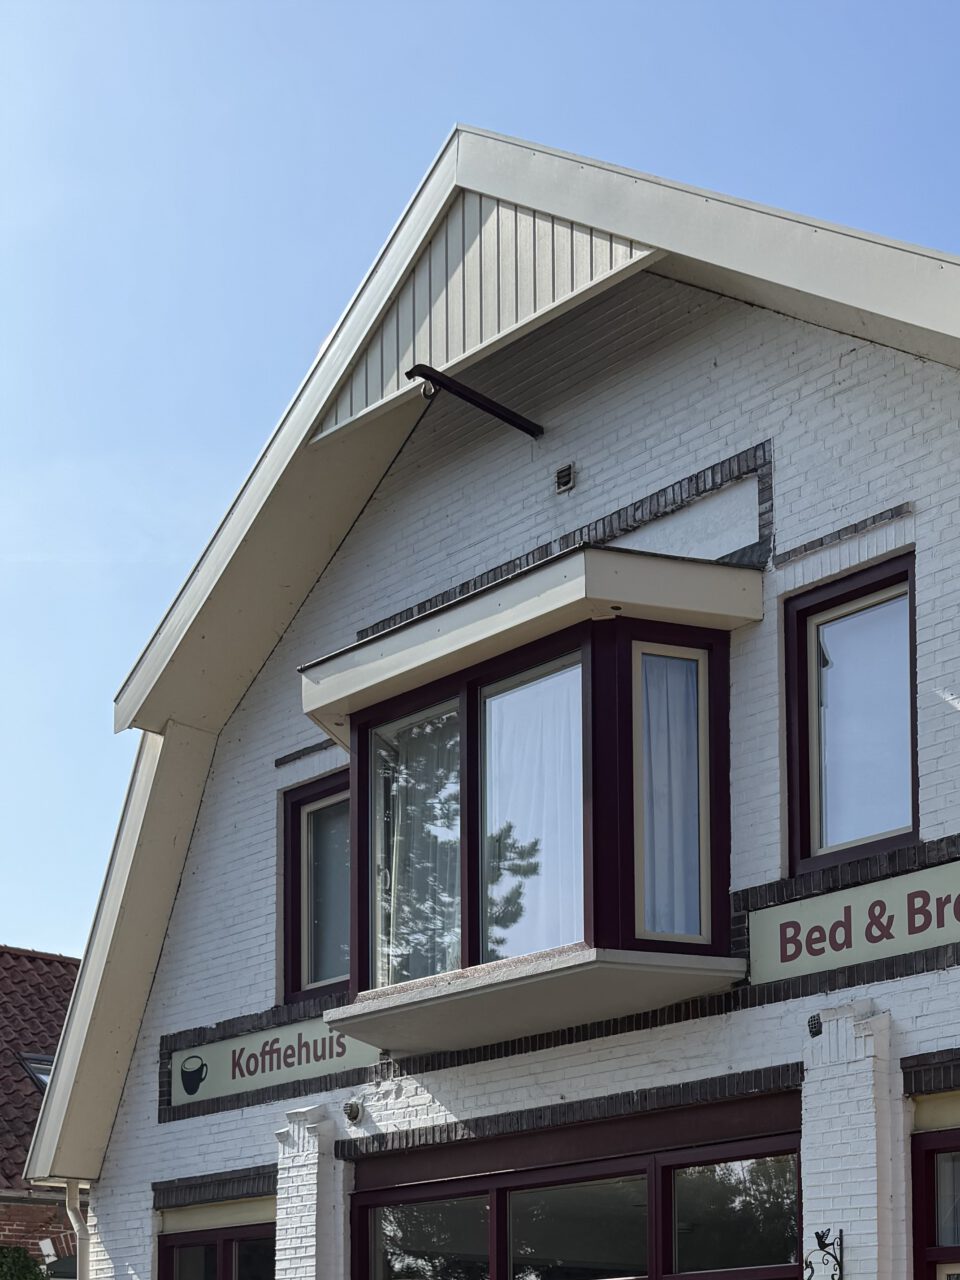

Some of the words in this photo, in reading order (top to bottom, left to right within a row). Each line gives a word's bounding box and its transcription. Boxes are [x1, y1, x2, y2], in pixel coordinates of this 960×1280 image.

[778, 904, 853, 963] Bed
[864, 899, 895, 944] &
[231, 1030, 347, 1080] Koffiehuis
